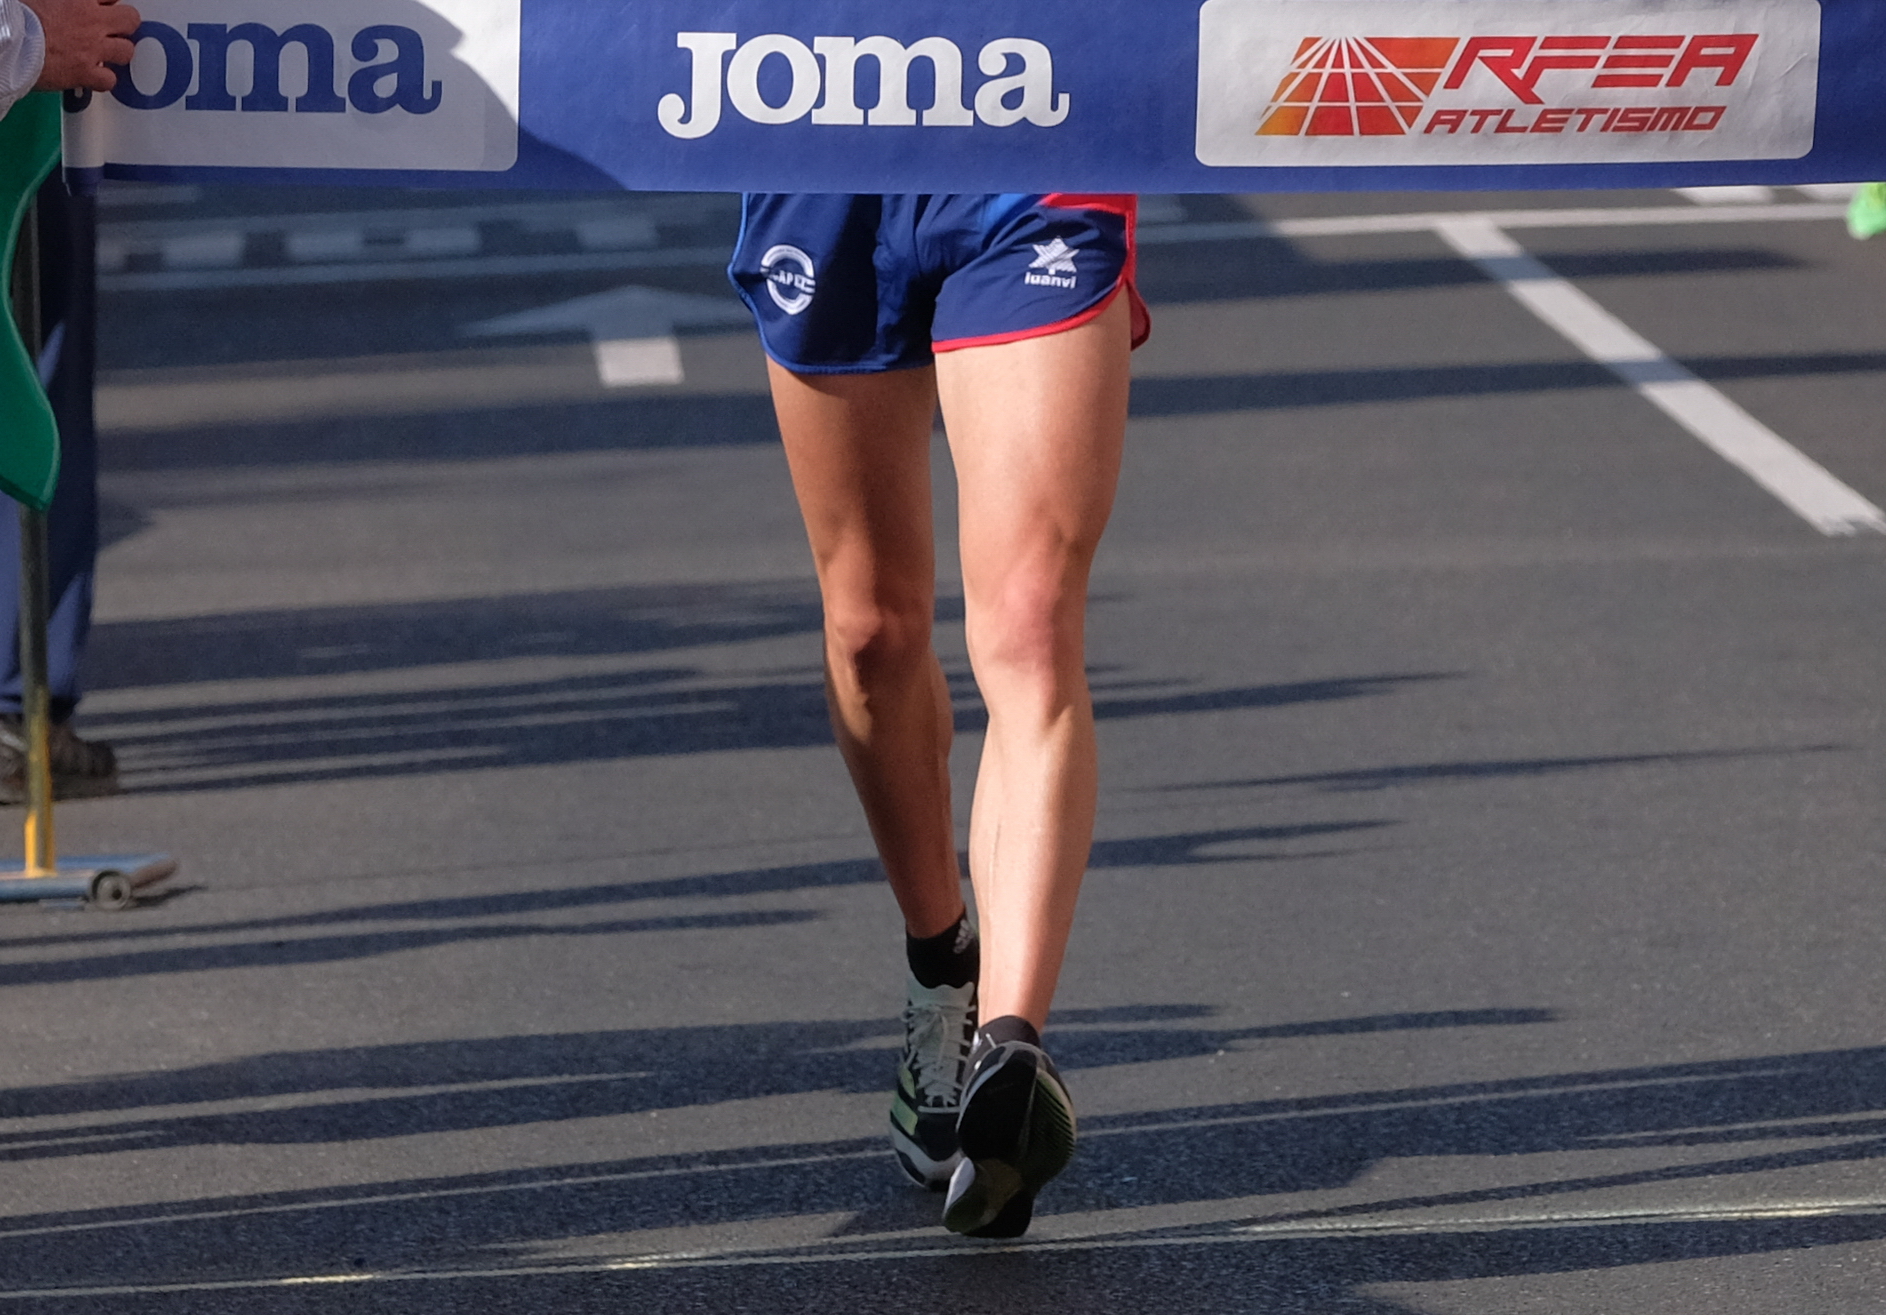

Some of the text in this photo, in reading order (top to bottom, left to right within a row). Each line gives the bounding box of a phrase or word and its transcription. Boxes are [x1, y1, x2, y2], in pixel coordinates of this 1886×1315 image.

[658, 32, 1070, 139] Joma
[1443, 33, 1760, 105] RFEA
[1424, 106, 1727, 134] ATLETISMO
